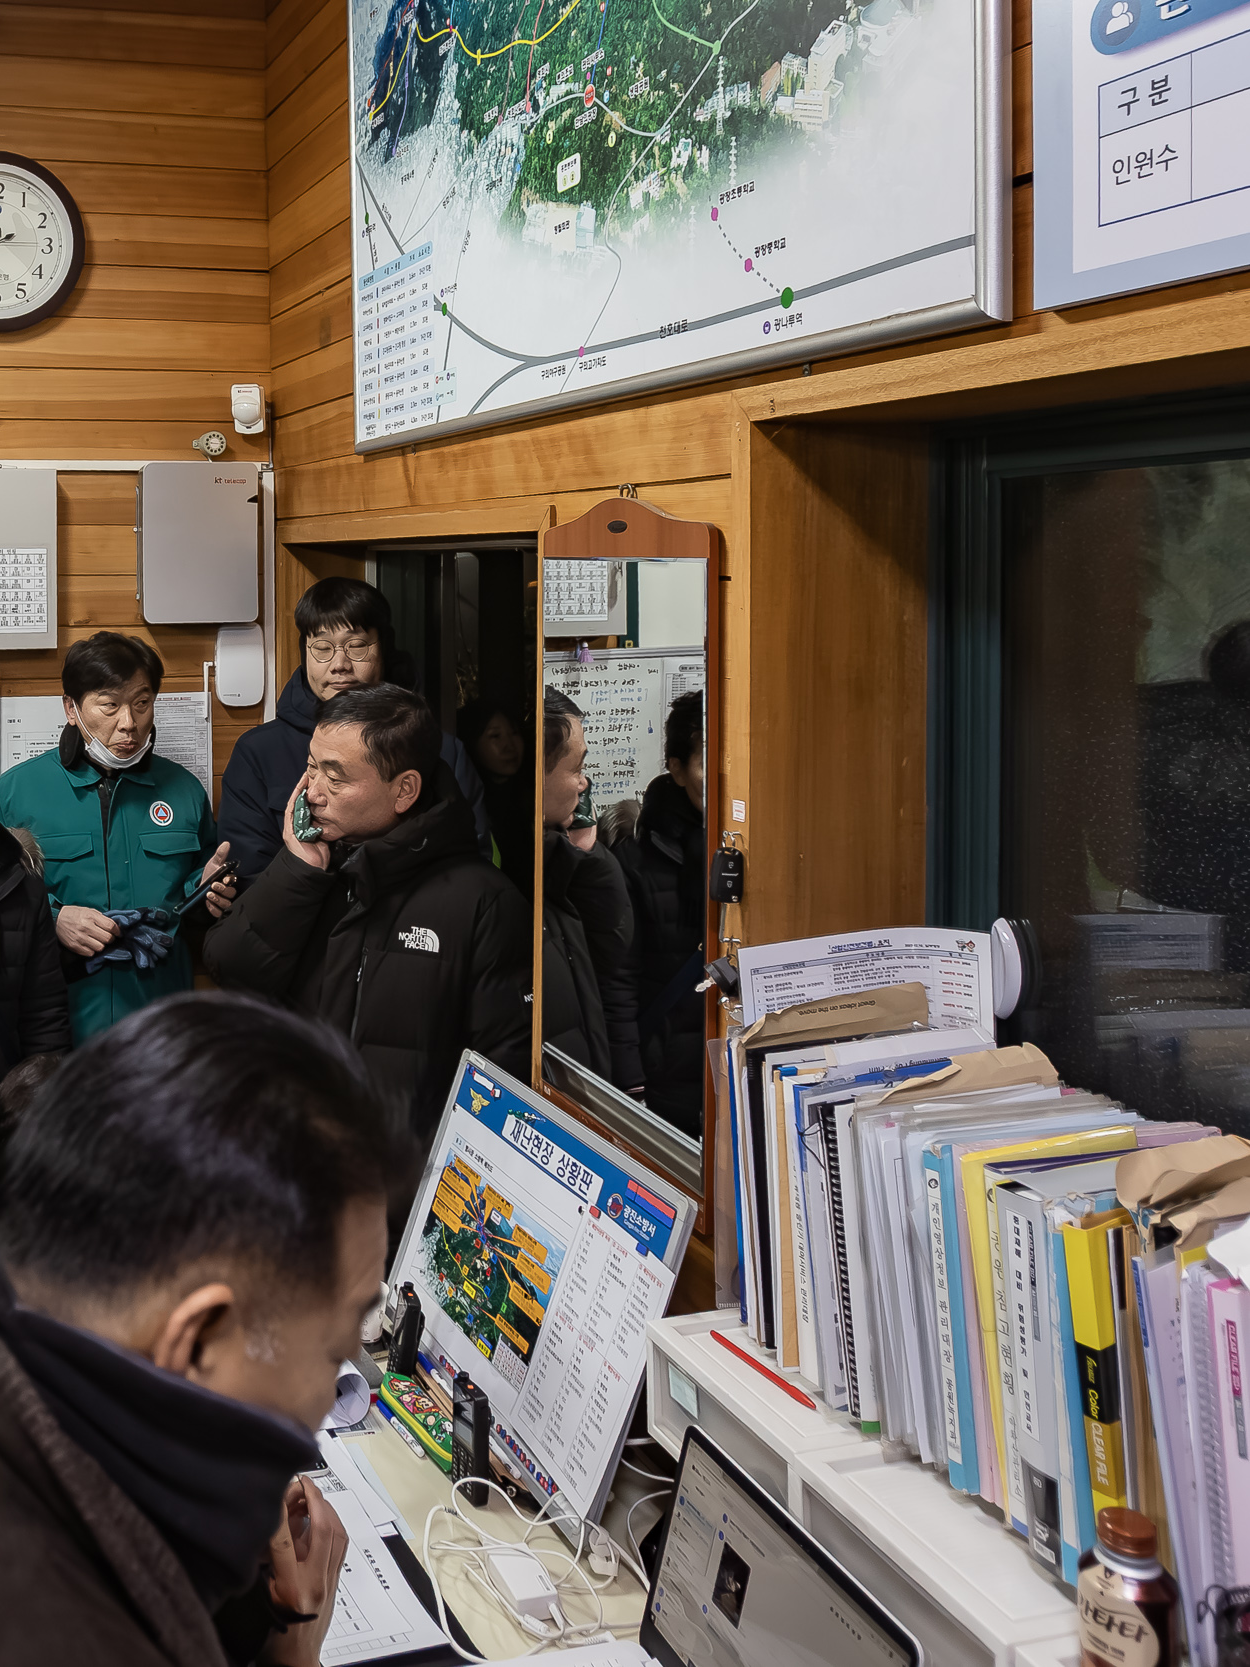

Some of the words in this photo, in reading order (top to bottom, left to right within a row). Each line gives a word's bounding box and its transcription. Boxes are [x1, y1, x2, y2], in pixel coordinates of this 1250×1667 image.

[1112, 143, 1179, 186] 인원수
[21, 191, 26, 208] 1
[719, 181, 756, 205] 광장초등학교
[37, 212, 47, 229] 2
[41, 237, 54, 255] 3
[754, 237, 787, 259] 광장중학교
[31, 263, 44, 280] 4
[15, 282, 27, 299] 5
[659, 319, 689, 340] 천호대로
[774, 312, 803, 331] 광나루역
[214, 476, 223, 484] kt
[224, 477, 247, 485] telecop
[398, 931, 427, 943] NORTH
[411, 926, 427, 936] THE
[404, 940, 426, 950] FACE
[509, 1118, 555, 1167] 재난현장
[556, 1155, 595, 1197] 상황판
[623, 1204, 657, 1238] 광진소방서
[1012, 1215, 1022, 1259] 중대재해
[1015, 1269, 1024, 1292] 대비
[1017, 1302, 1028, 1357] 위험성평가
[1227, 1324, 1238, 1353] CLEAR
[1230, 1354, 1239, 1373] FILE
[1023, 1390, 1034, 1434] 안전교육
[1088, 1388, 1100, 1420] Color
[1091, 1422, 1106, 1459] CLEAR
[1095, 1460, 1110, 1487] FILE
